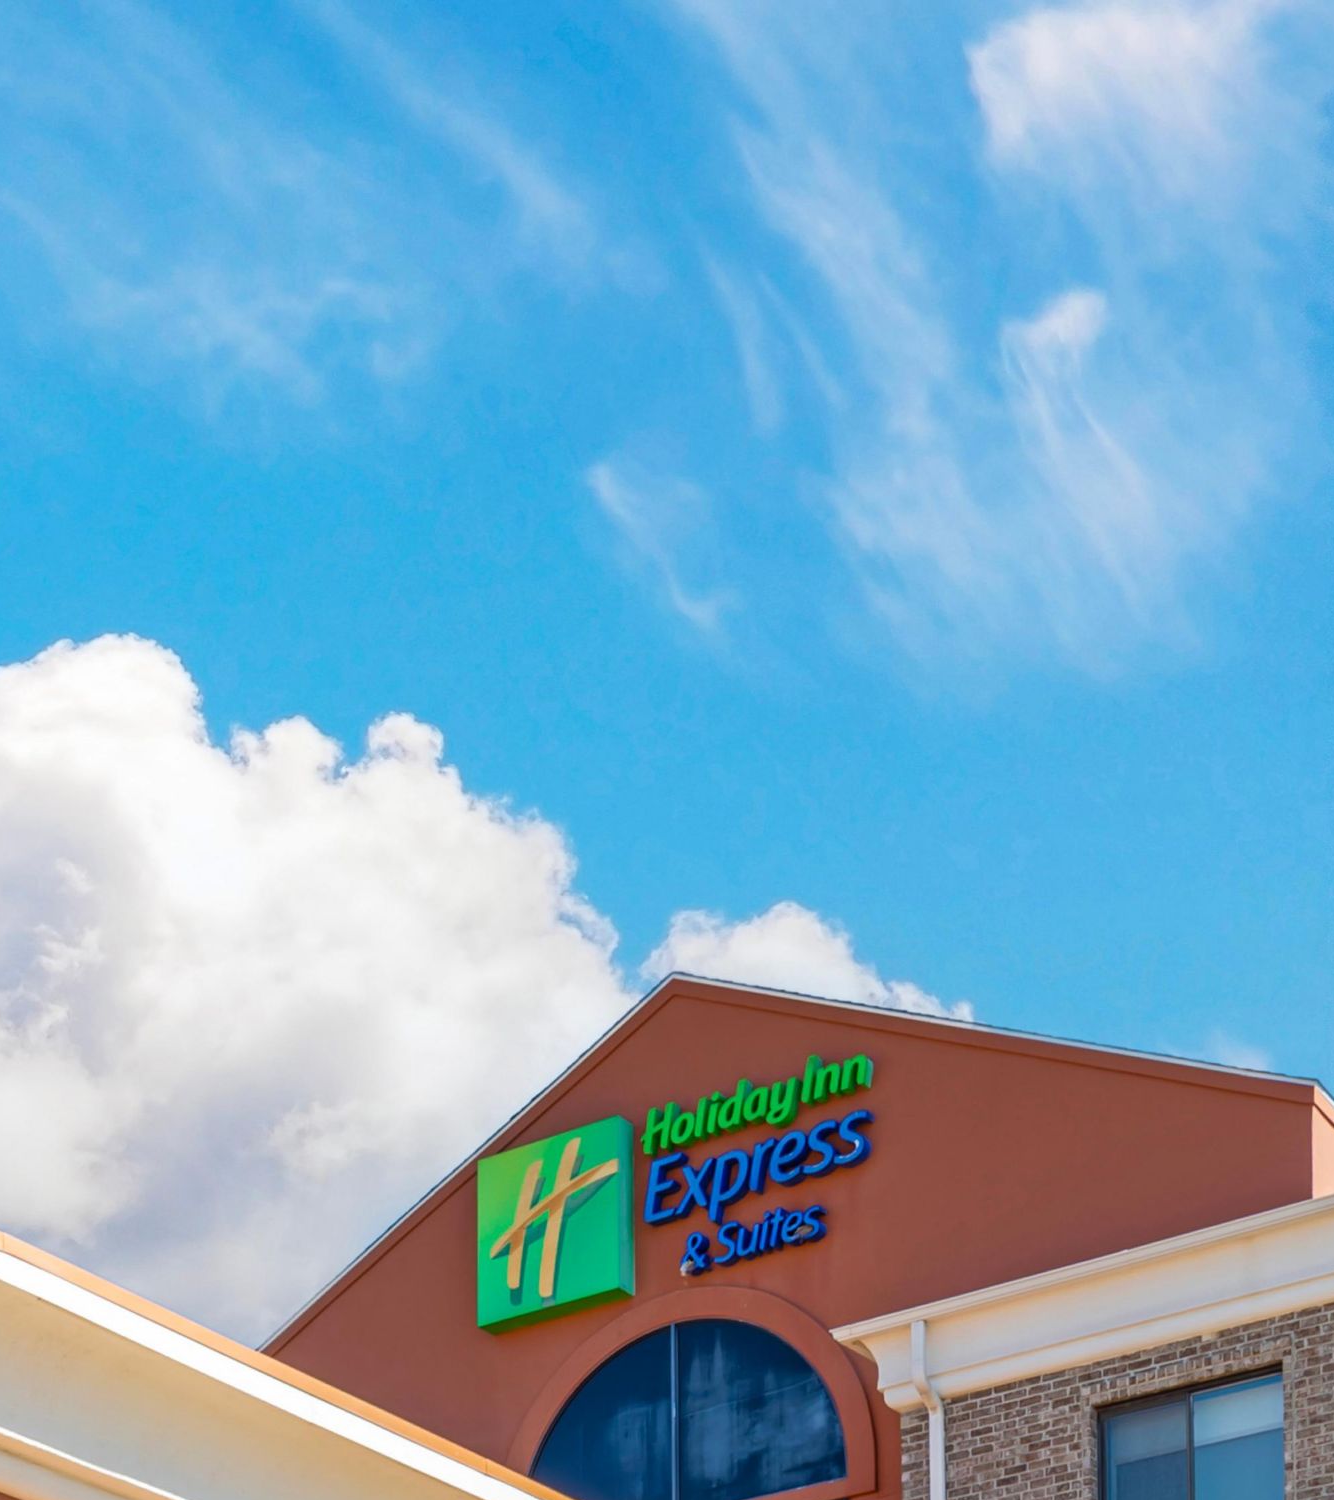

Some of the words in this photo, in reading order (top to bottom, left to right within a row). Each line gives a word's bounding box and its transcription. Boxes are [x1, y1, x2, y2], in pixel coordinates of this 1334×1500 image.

[641, 1078, 799, 1156] Holiday
[801, 1053, 873, 1104] Inn
[643, 1110, 874, 1226] Express
[681, 1231, 710, 1276] &
[715, 1204, 828, 1267] Suites
